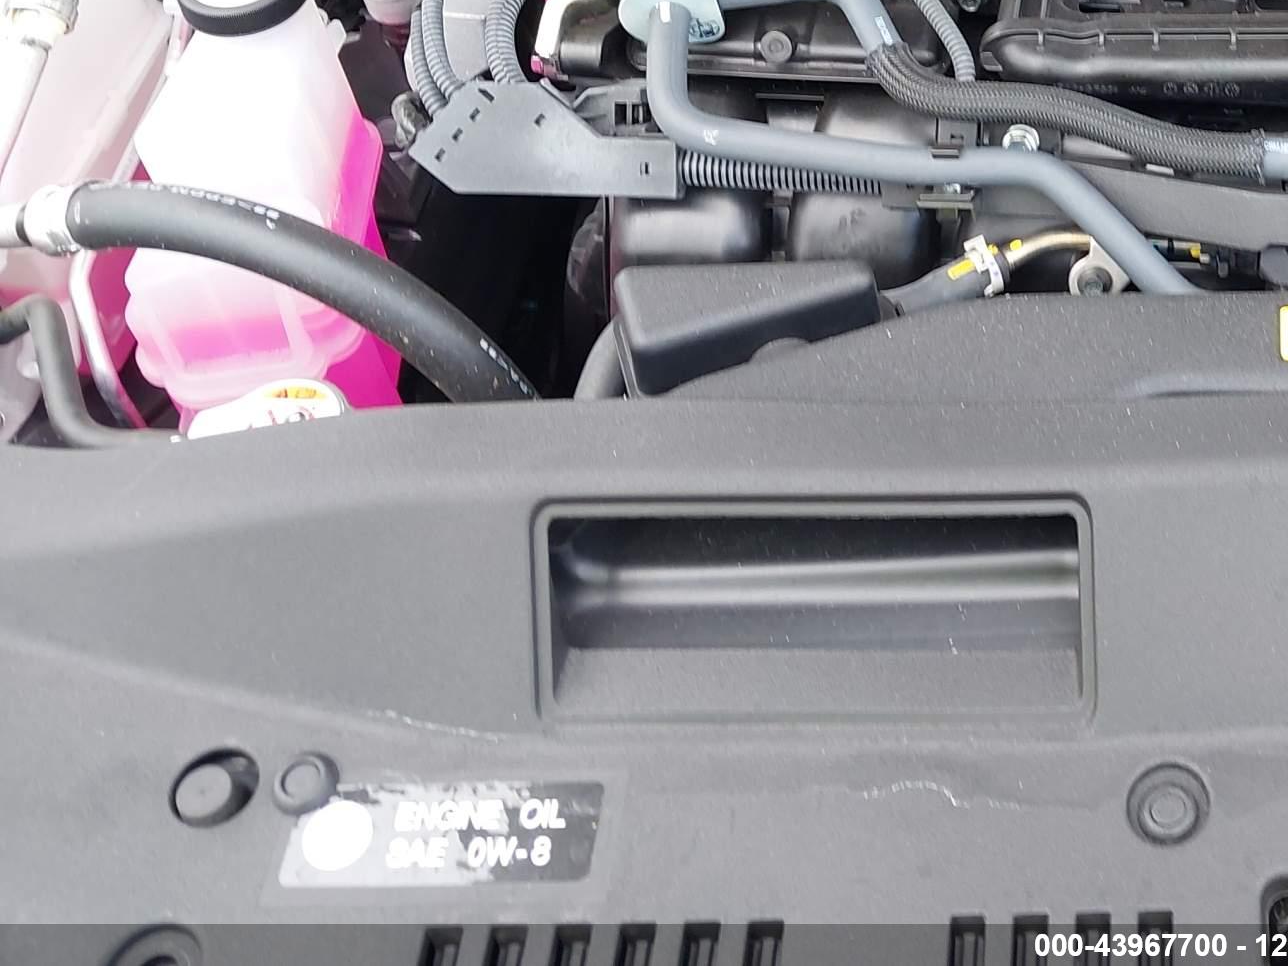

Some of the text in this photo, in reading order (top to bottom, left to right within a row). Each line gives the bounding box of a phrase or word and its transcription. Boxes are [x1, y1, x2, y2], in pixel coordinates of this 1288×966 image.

[394, 798, 566, 831] ENGINE OIL
[385, 835, 552, 869] SAE 0W-8
